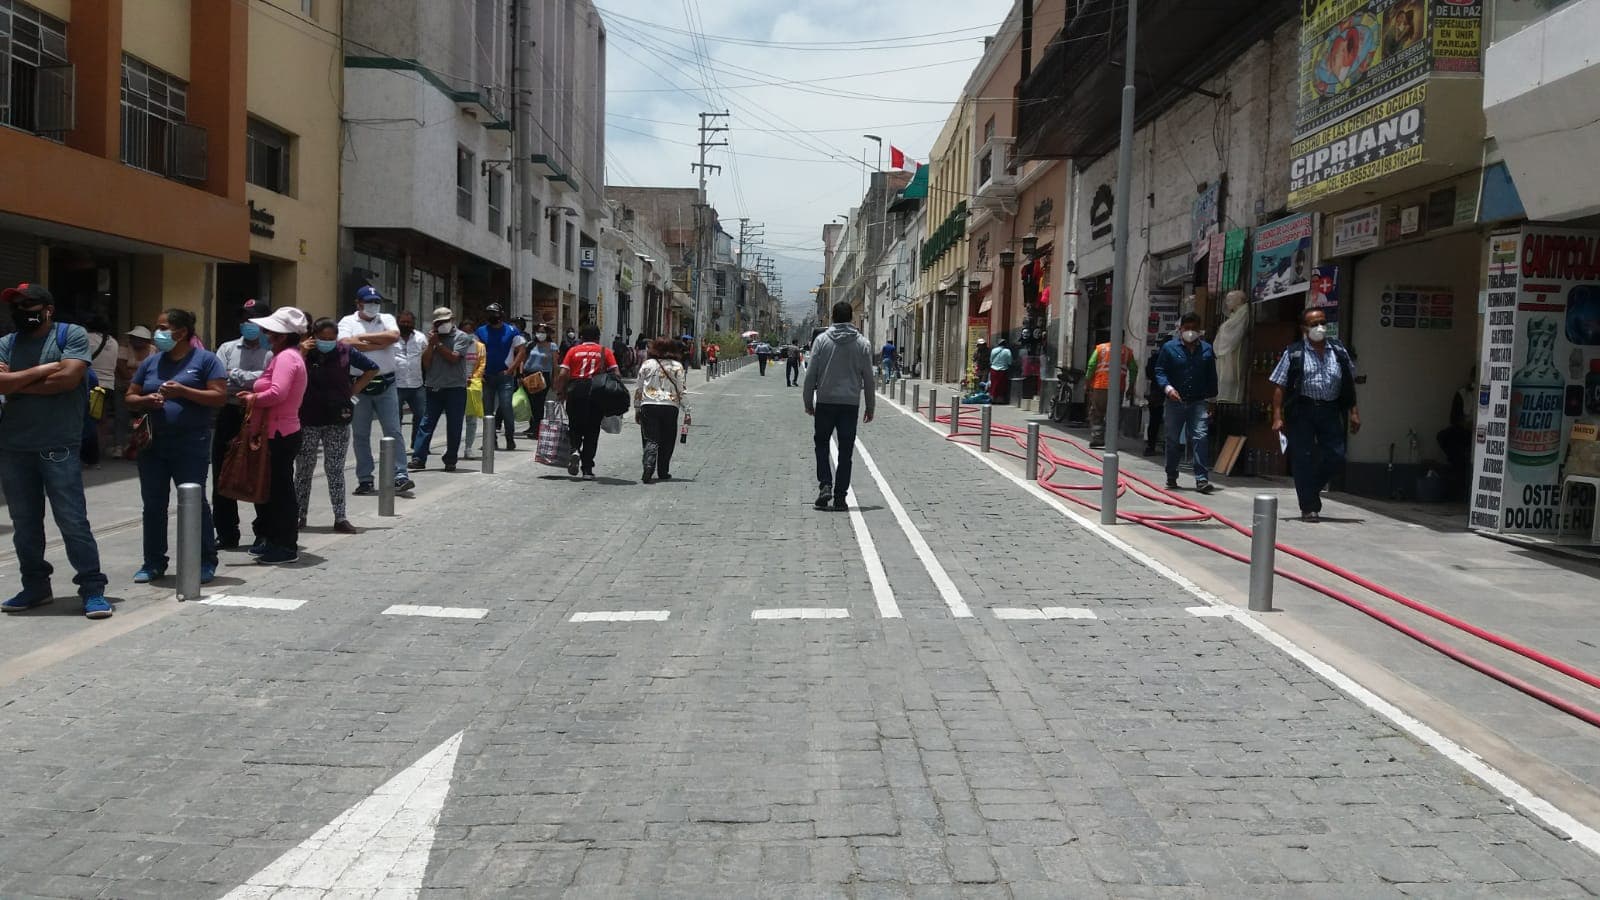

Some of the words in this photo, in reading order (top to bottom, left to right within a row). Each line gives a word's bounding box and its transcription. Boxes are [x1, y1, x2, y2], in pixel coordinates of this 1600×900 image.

[1436, 6, 1447, 16] DE
[1450, 6, 1461, 16] LA
[1463, 6, 1480, 16] PAZ
[1441, 30, 1451, 38] EN
[1456, 31, 1474, 39] UNIR
[1437, 40, 1477, 49] PAREJAS
[1434, 49, 1479, 57] SEPARADAS
[1372, 70, 1392, 86] PISO
[1408, 53, 1425, 67] 204
[1291, 134, 1321, 158] MAESTRO
[1322, 127, 1332, 146] DE
[1332, 120, 1346, 140] LAS
[1347, 106, 1384, 133] CIENCIAS
[1386, 87, 1425, 116] OCULTAS
[1291, 108, 1420, 180] CIPRIANO
[1291, 180, 1305, 192] DE
[1307, 172, 1321, 186] LA
[1324, 162, 1346, 179] PAZ
[584, 250, 591, 260] E
[1505, 508, 1554, 529] DOLOR
